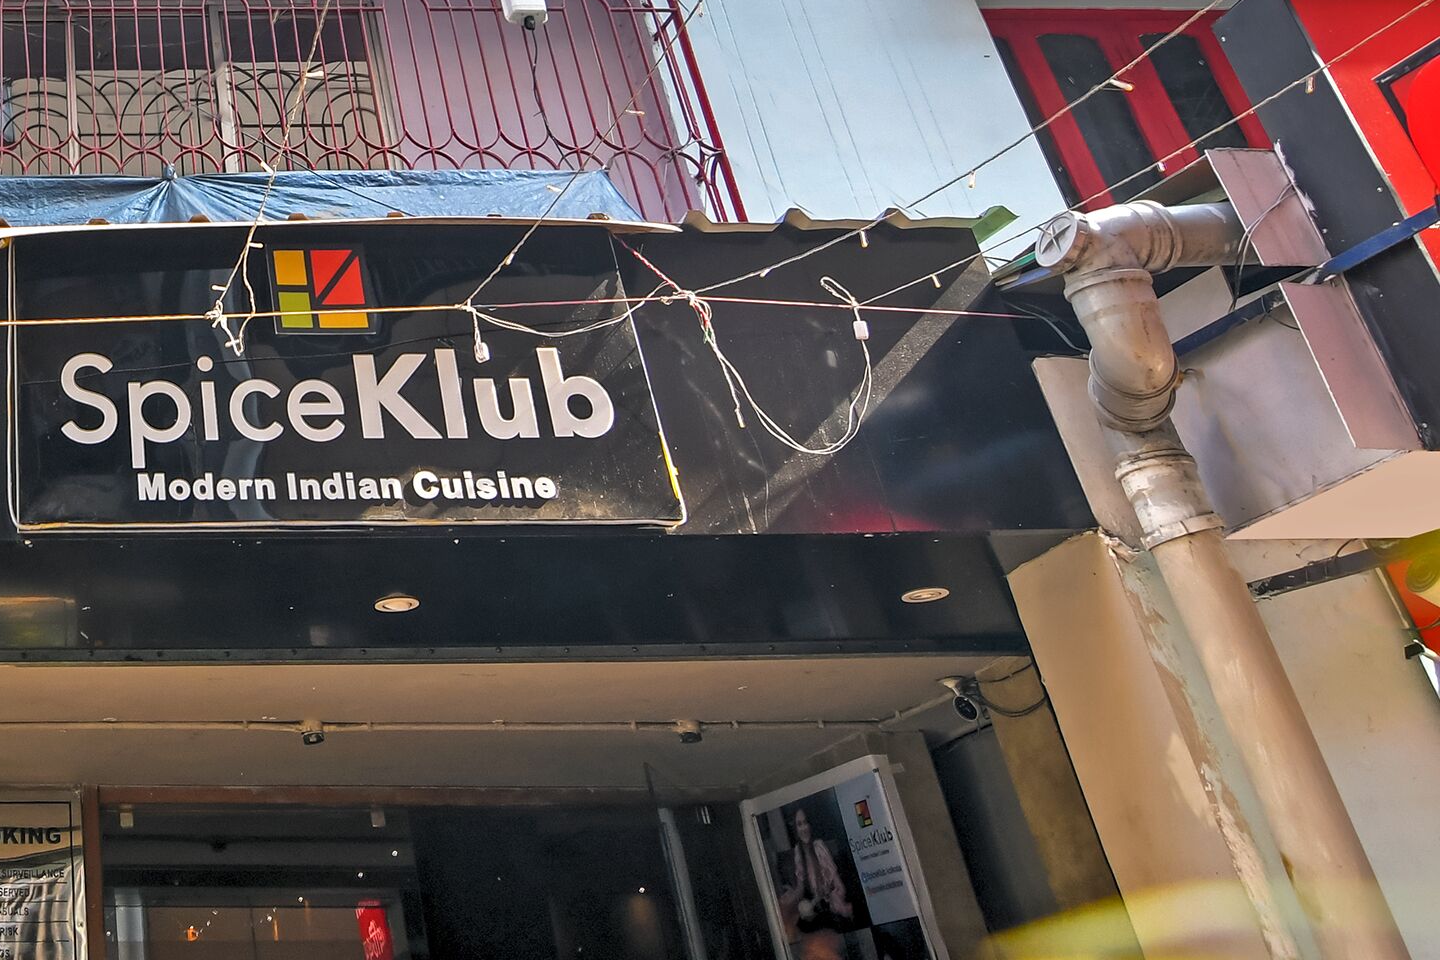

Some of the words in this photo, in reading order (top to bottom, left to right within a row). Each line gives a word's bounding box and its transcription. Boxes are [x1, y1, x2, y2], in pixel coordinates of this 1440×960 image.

[59, 346, 615, 469] SpiceKlub
[136, 472, 277, 503] Modern
[288, 471, 402, 502] Indian
[413, 470, 557, 501] Cuisine
[849, 826, 894, 855] SpiceKlub
[1, 868, 65, 880] SURVEILLANCE
[0, 926, 19, 936] RISK
